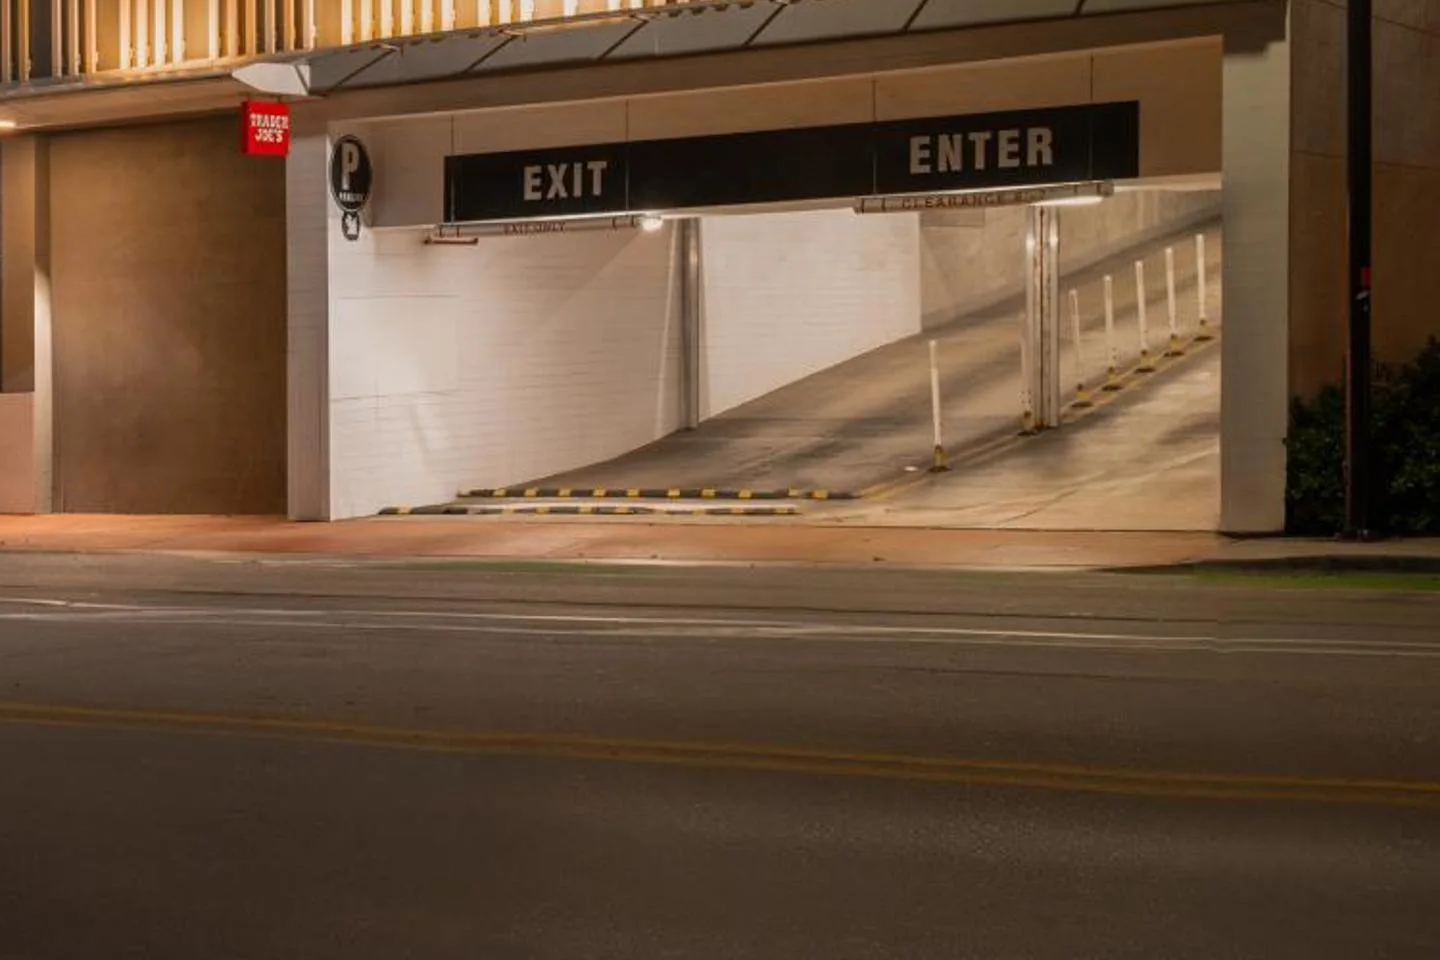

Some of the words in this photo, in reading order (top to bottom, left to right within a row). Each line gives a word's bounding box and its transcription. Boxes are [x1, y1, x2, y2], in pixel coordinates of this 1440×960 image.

[341, 141, 360, 191] P
[909, 126, 1054, 175] ENTER
[521, 159, 608, 201] EXIT
[901, 193, 1004, 209] CLEARANCE
